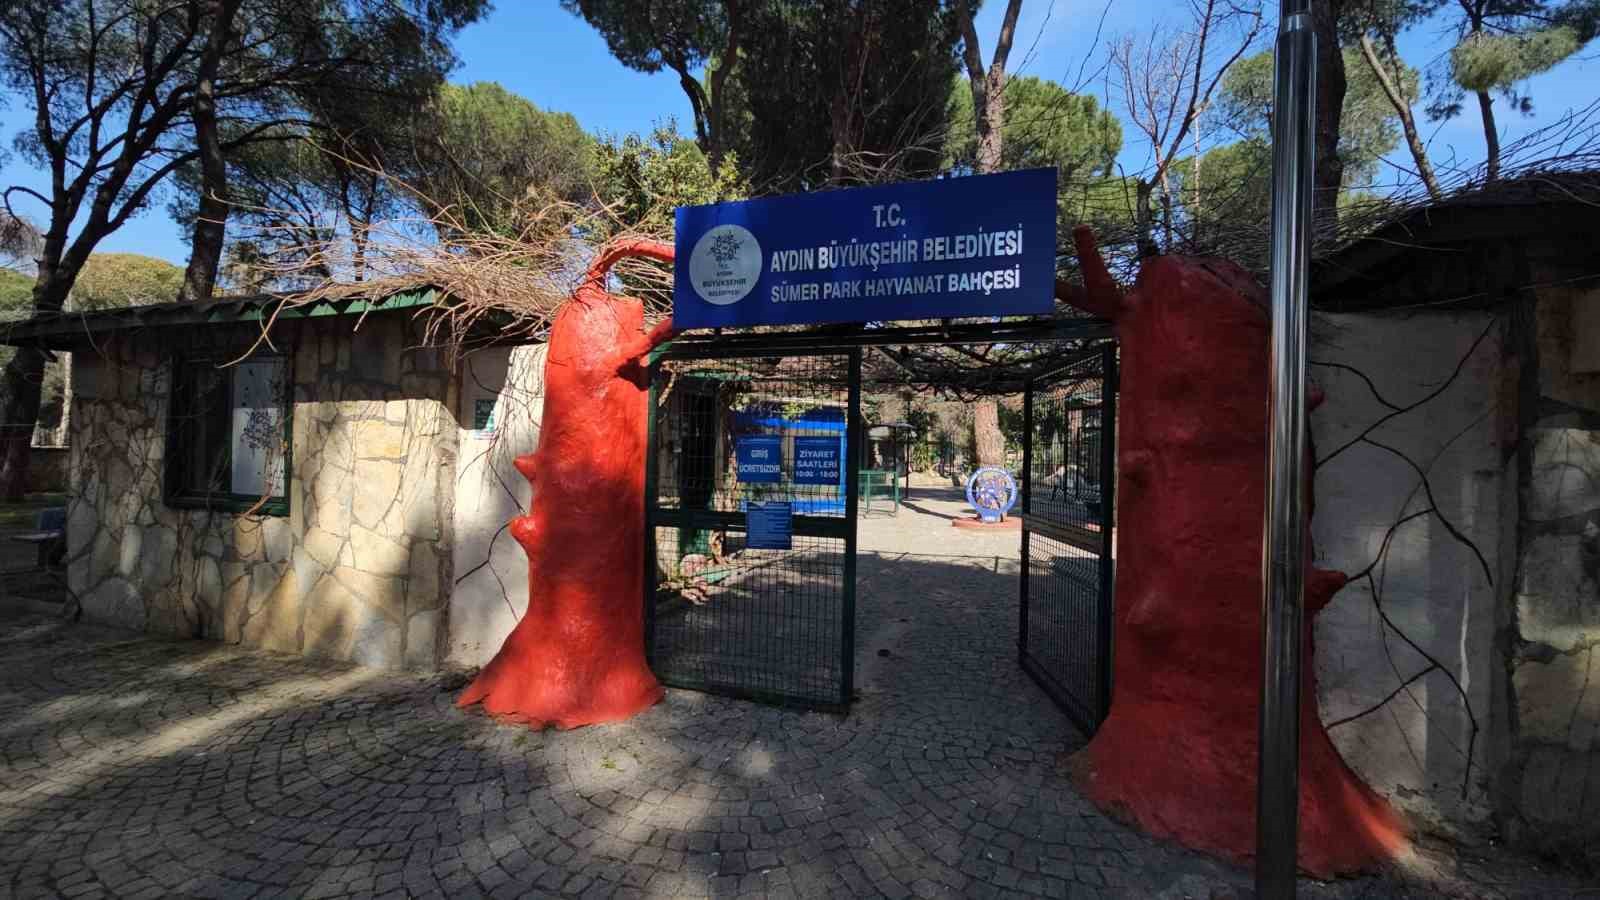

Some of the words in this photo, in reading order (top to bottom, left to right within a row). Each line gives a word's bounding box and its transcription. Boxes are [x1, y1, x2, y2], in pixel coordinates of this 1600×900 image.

[872, 203, 907, 228] T.C.
[770, 249, 815, 273] AYDIN
[818, 234, 918, 271] BÜYÜKŞEHİR
[923, 223, 1023, 261] BELEDİYESİ
[770, 279, 820, 303] SÜMER
[823, 276, 861, 300] PARK
[865, 274, 943, 297] HAYVANAT
[948, 263, 1021, 296] BAHÇESİ
[796, 459, 838, 468] SAATLERİ
[799, 449, 835, 458] ZİYARET
